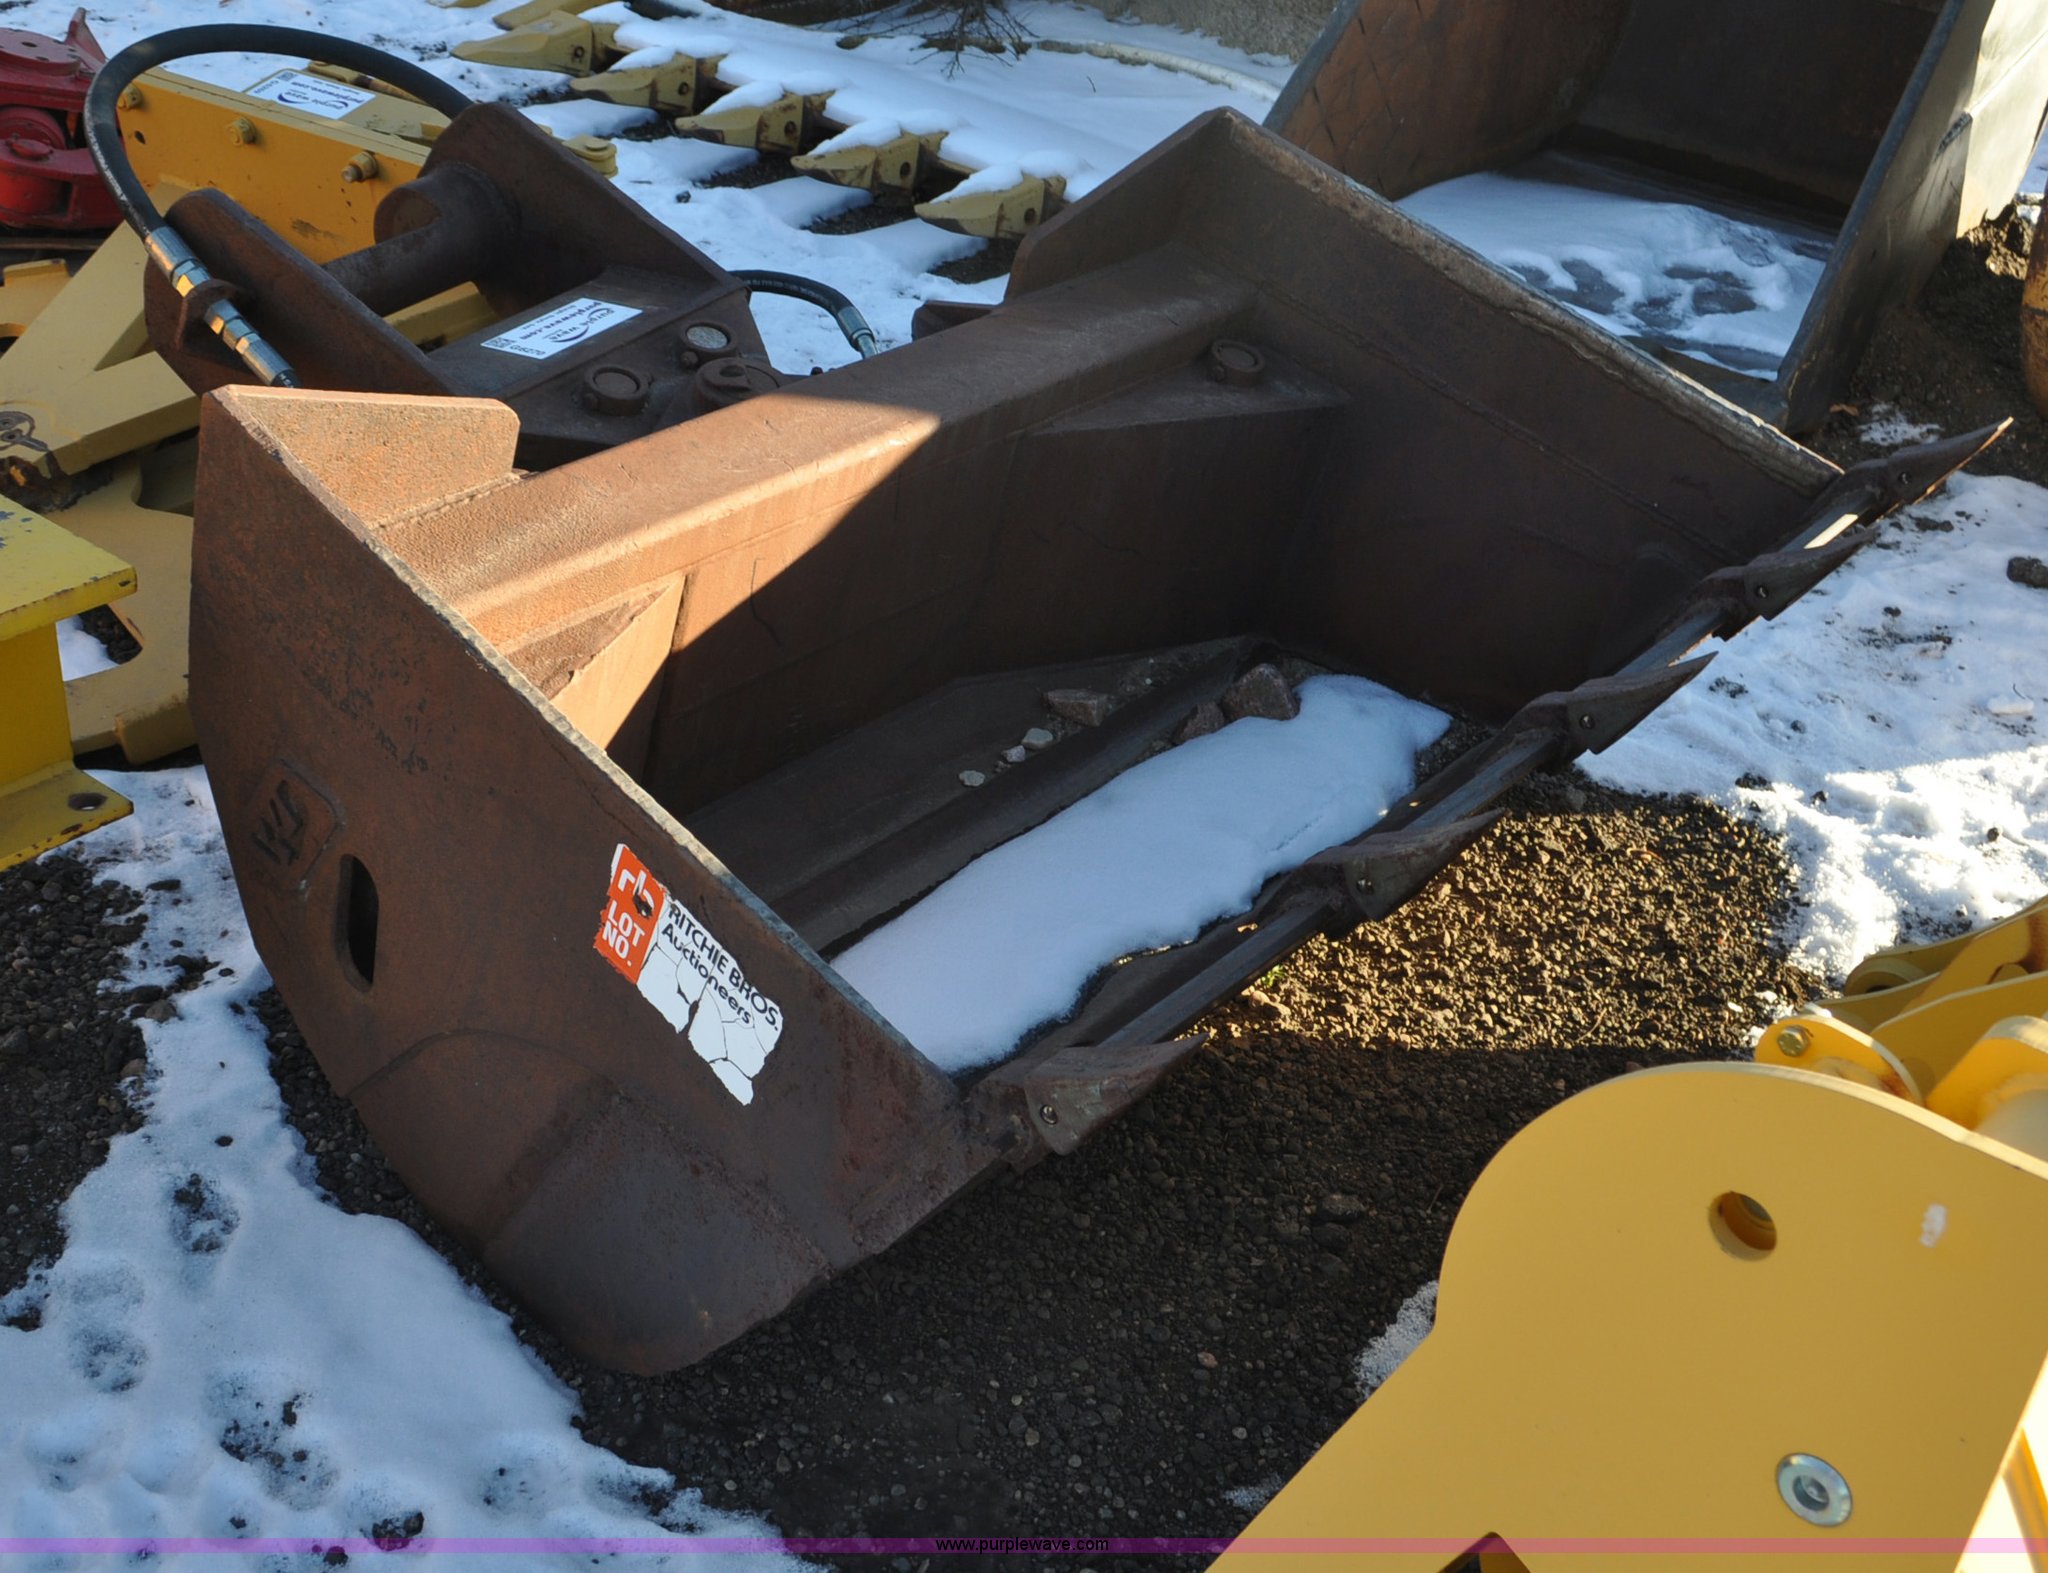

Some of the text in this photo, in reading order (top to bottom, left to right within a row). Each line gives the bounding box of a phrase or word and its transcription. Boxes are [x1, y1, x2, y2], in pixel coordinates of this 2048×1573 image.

[520, 302, 603, 340] purplewave.com
[550, 326, 579, 341] wave
[579, 307, 615, 325] purple
[602, 923, 633, 968] NO.
[607, 899, 646, 948] LOT
[661, 923, 751, 1025] Auctioneers
[667, 902, 779, 1032] RITCHIE BROS.
